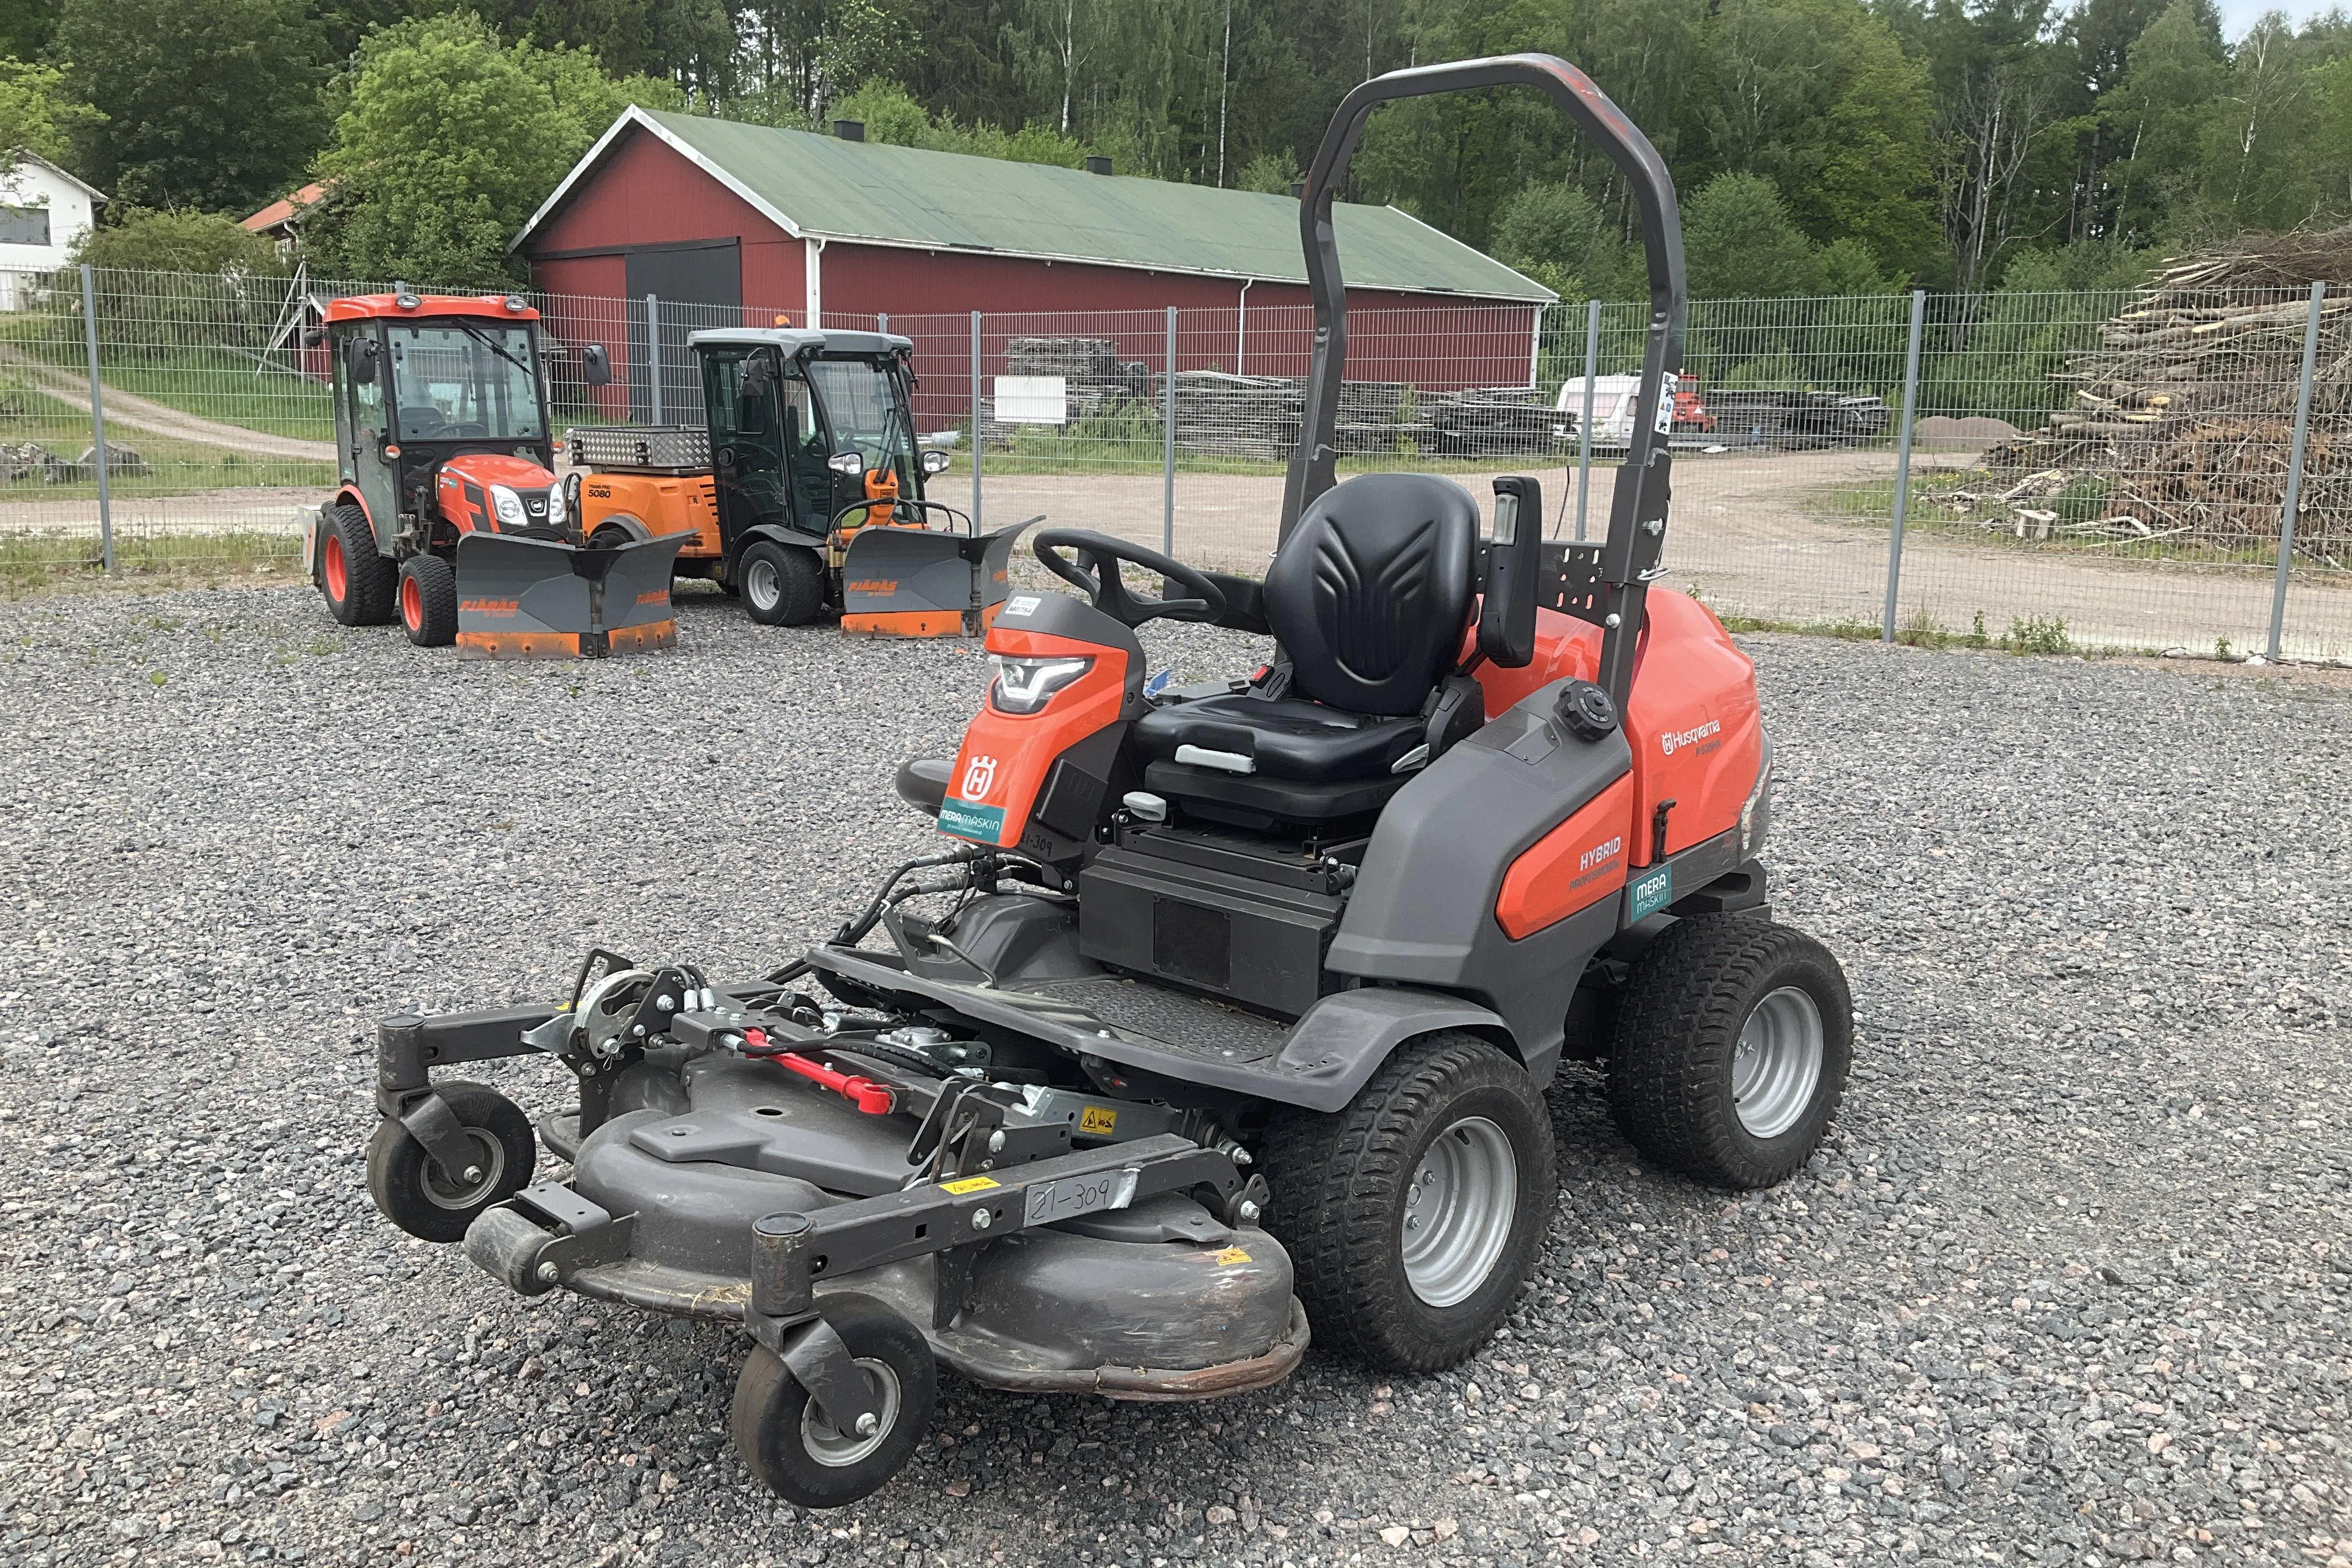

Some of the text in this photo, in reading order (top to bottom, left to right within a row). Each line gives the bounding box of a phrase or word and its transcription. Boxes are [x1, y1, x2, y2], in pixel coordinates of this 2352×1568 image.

[1672, 720, 1720, 749] Husqvarna
[1580, 836, 1620, 871] HYBRID
[1637, 874, 1665, 901] MERA
[1031, 1180, 1109, 1219] 21-309
